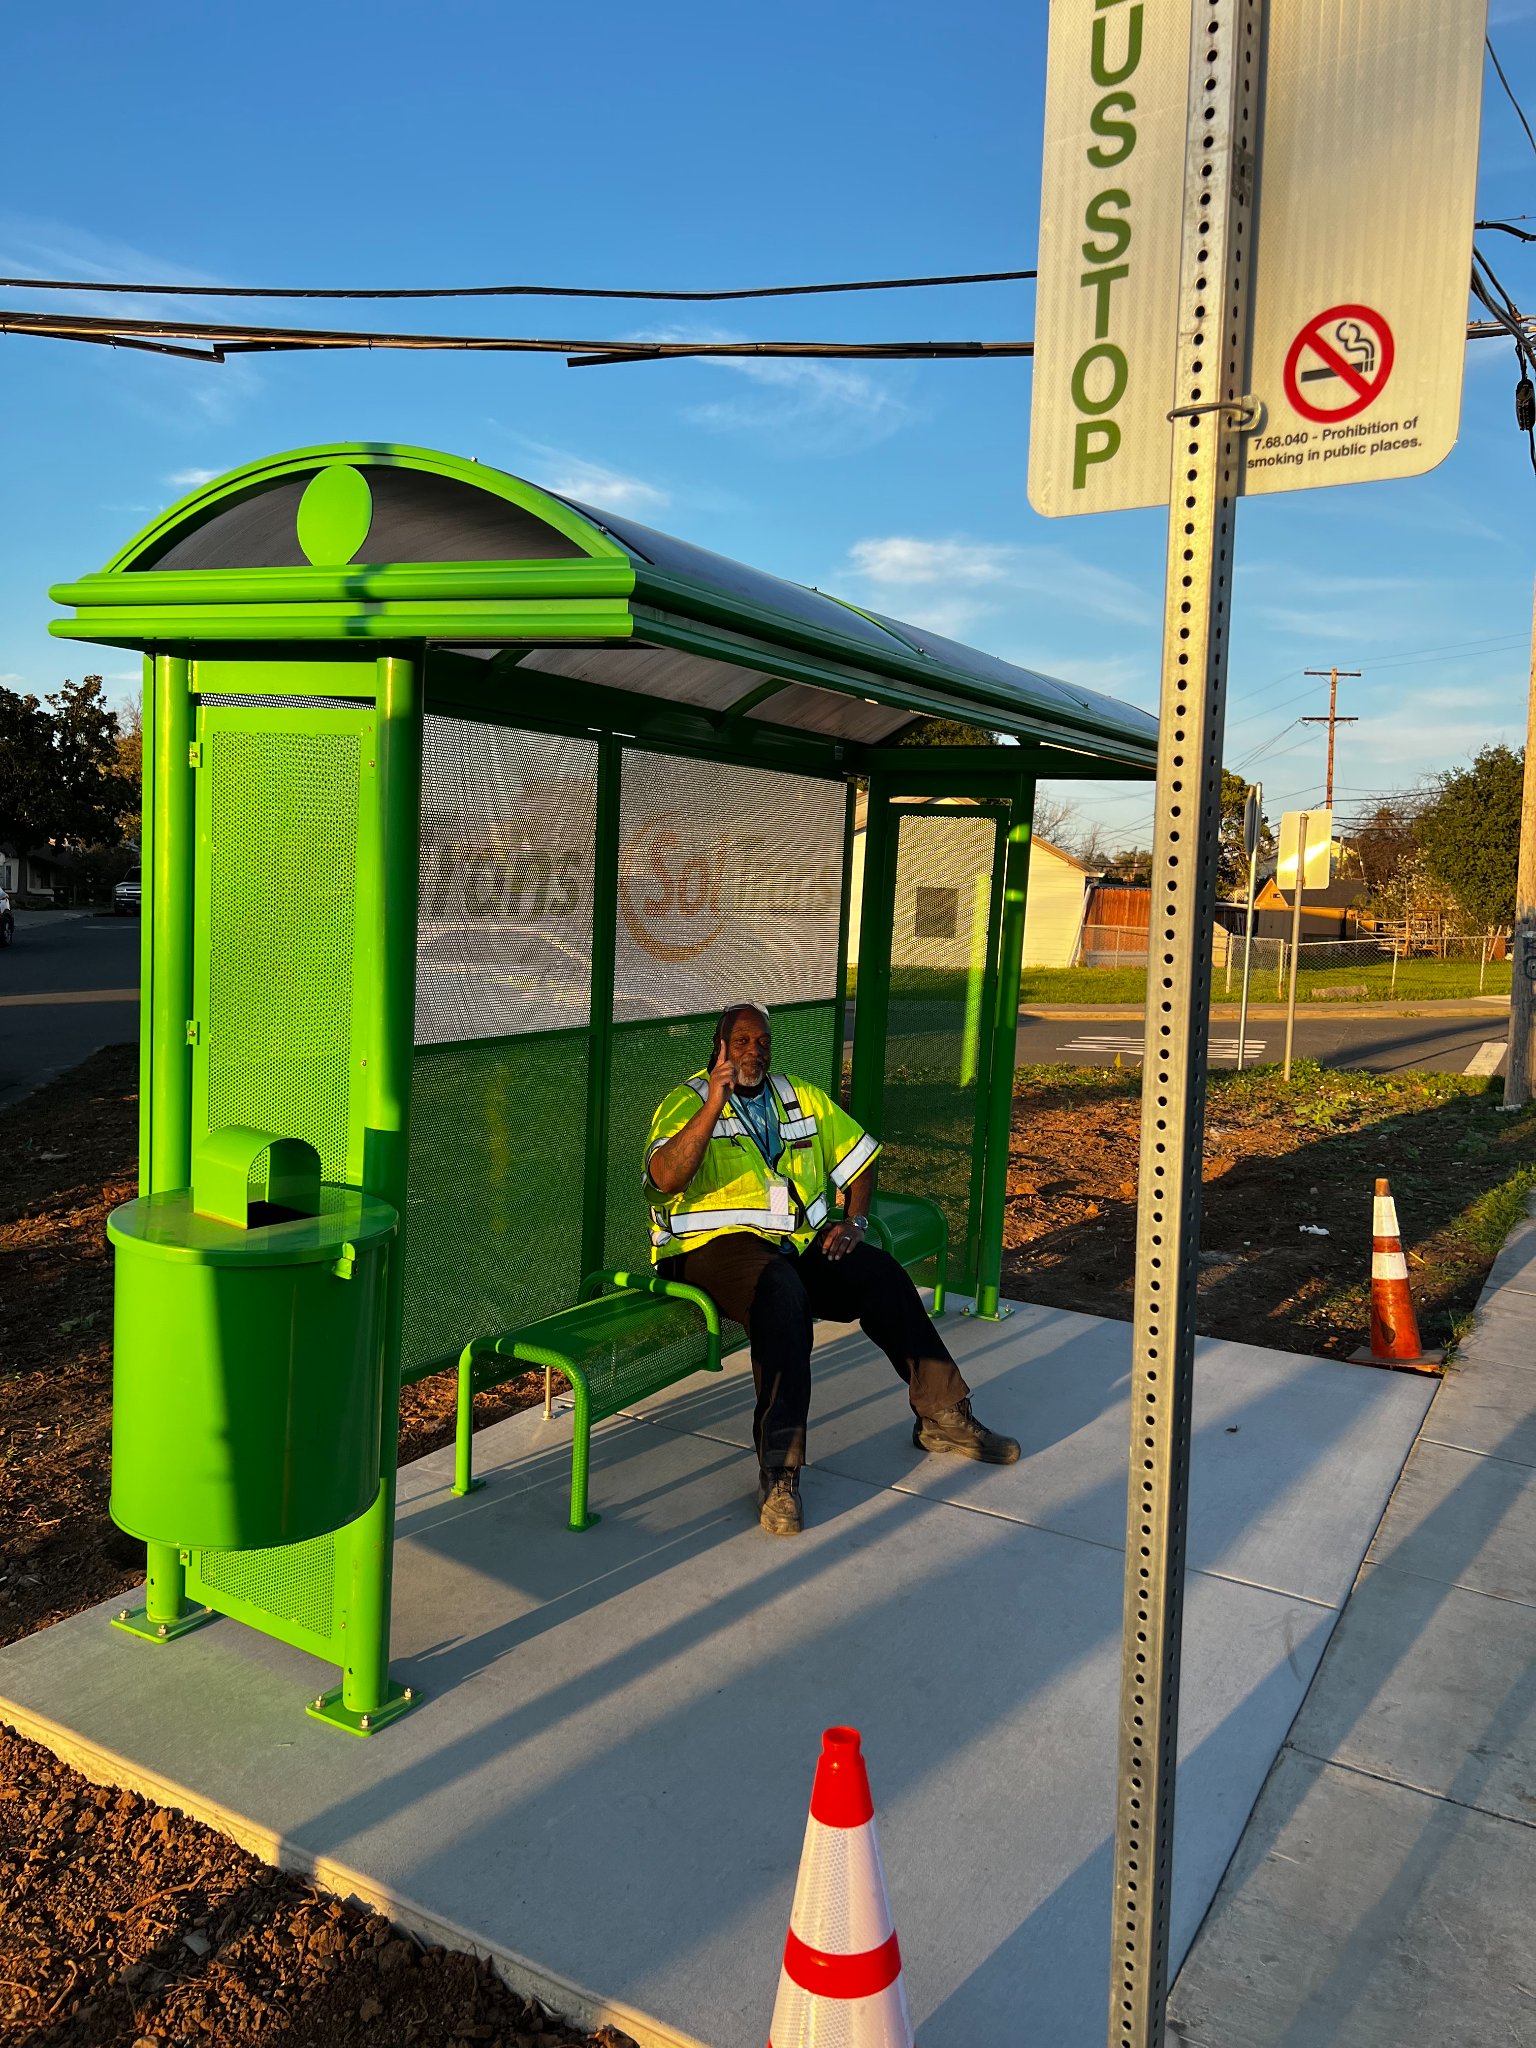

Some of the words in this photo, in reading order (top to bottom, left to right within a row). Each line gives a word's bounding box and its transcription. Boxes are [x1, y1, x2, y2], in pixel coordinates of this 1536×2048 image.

[1086, 0, 1144, 169] US
[1071, 188, 1132, 490] STOP
[1247, 450, 1304, 469] smoking
[1307, 449, 1320, 461] in
[1323, 442, 1367, 461] public
[1370, 436, 1422, 456] places.
[1254, 432, 1309, 451] 7.68.040
[1322, 421, 1399, 441] Prohibition
[1402, 416, 1419, 430] of
